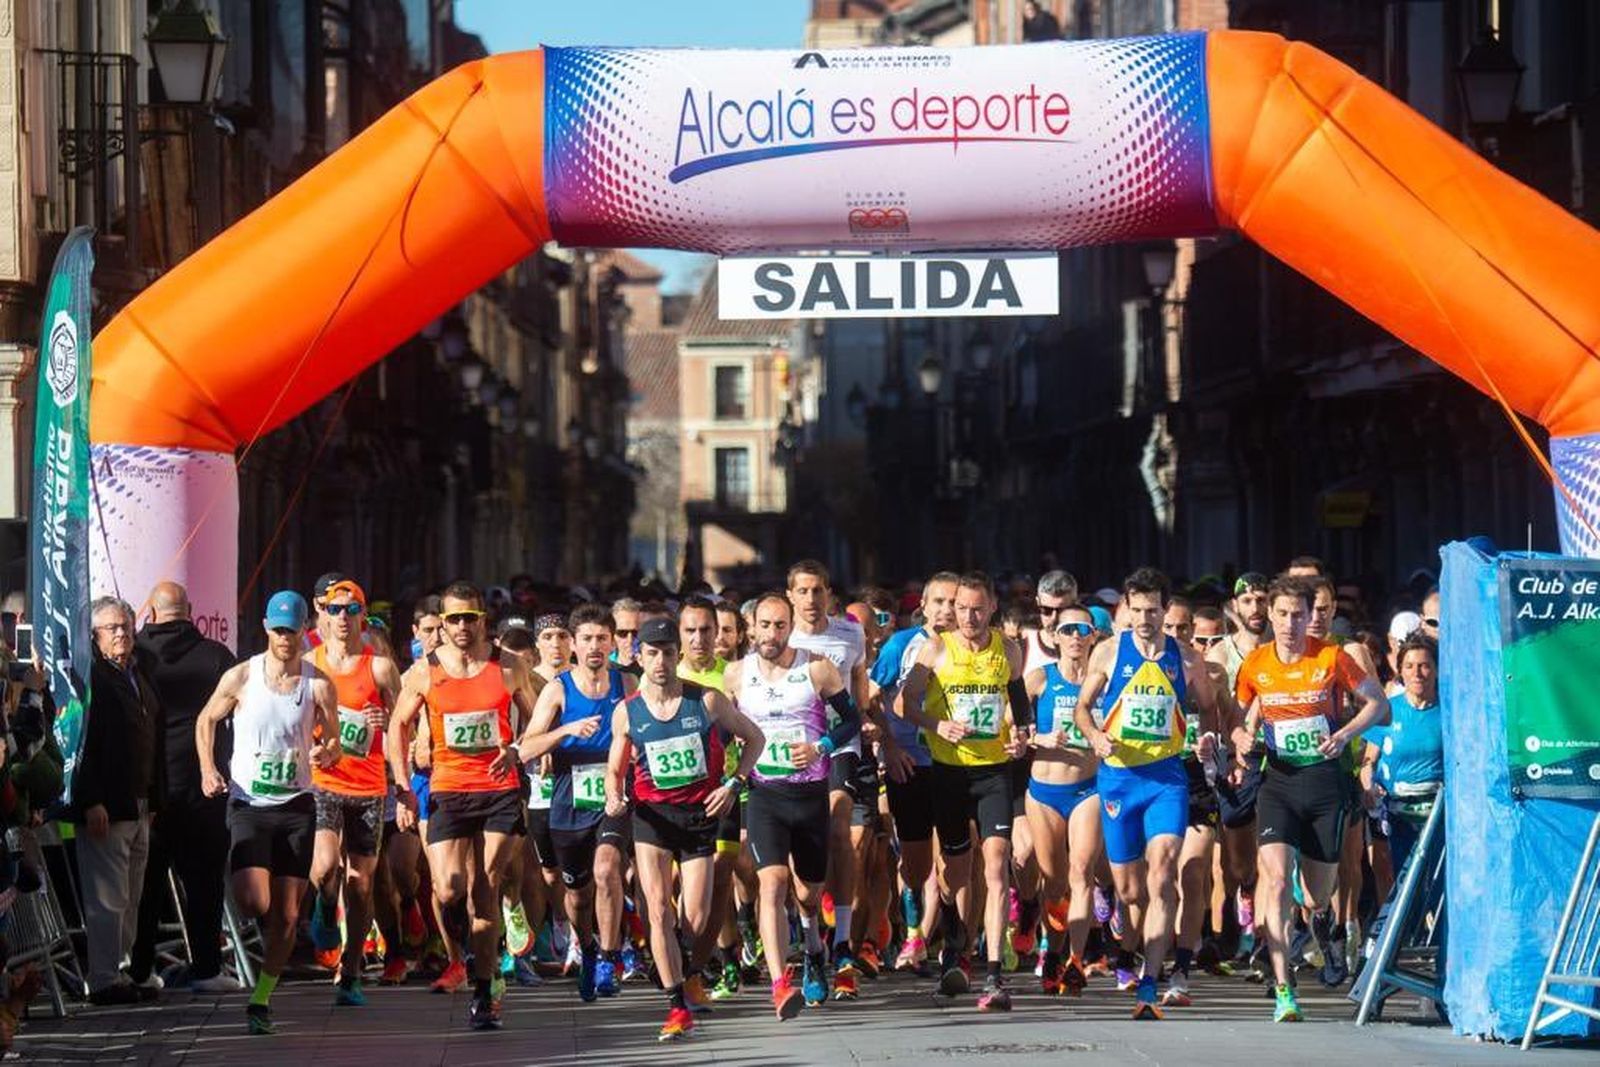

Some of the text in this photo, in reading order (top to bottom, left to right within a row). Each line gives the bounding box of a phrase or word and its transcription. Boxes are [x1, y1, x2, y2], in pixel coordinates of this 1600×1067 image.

[675, 84, 1070, 166] Alcalá es deporte
[753, 259, 1023, 312] SALIDA
[43, 422, 56, 570] Atletismo
[42, 577, 52, 615] de
[1518, 577, 1598, 595] Club de
[1517, 602, 1600, 619] A.J. Alk
[1134, 684, 1165, 695] UCA
[969, 706, 994, 727] 12
[1130, 708, 1167, 728] 538
[455, 722, 491, 744] 278
[1284, 730, 1323, 753] 695
[657, 749, 698, 774] 338
[768, 742, 791, 761] 11
[260, 762, 297, 781] 518
